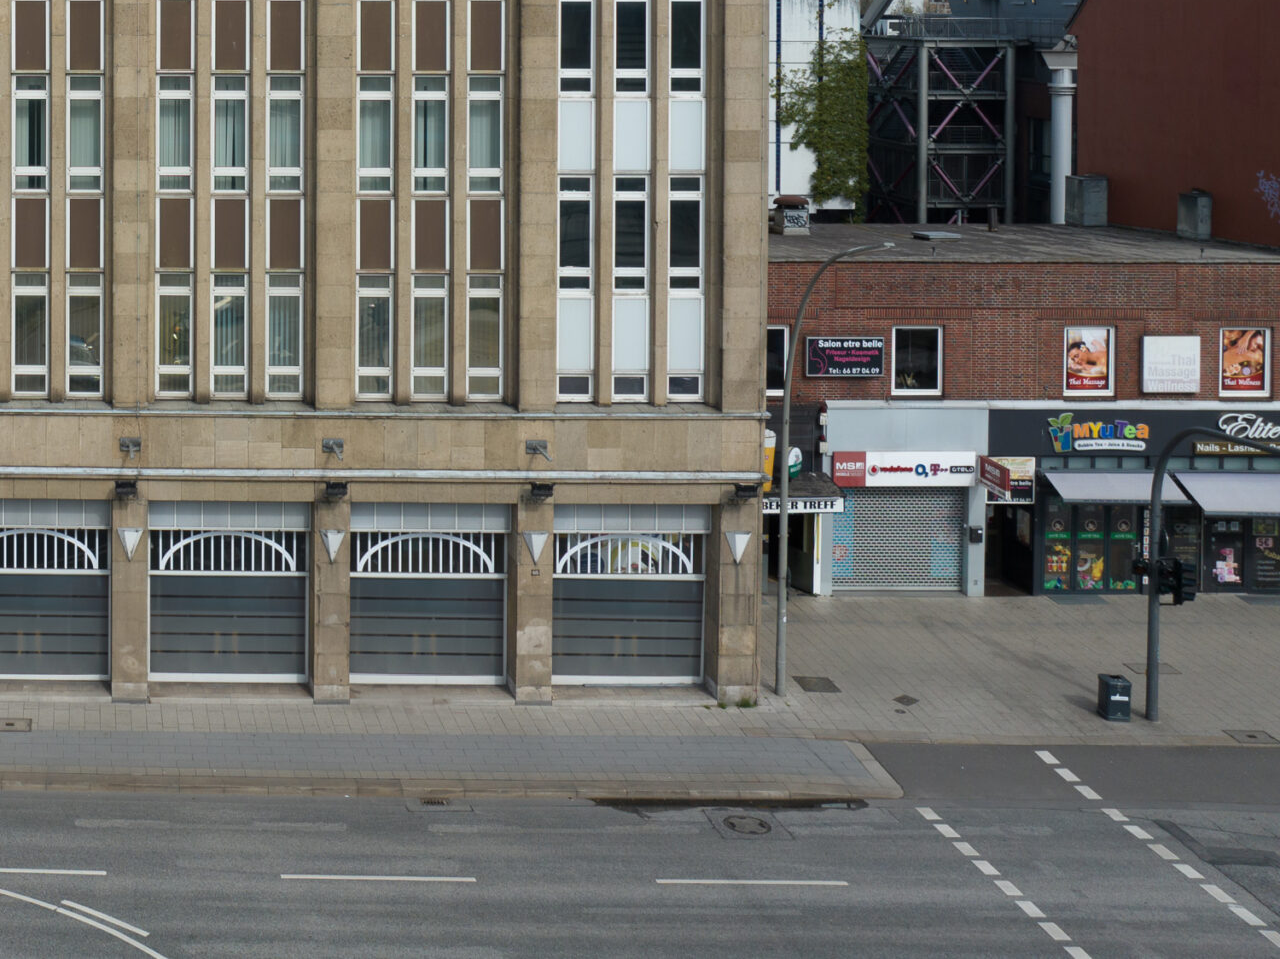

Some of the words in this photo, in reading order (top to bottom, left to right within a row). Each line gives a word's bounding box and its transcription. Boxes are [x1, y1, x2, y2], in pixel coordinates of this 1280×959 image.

[818, 340, 841, 348] Salon
[843, 340, 861, 348] etre
[862, 340, 883, 348] belle
[1170, 353, 1196, 366] Thai
[1147, 366, 1197, 379] Massage
[1147, 380, 1197, 392] Wellness
[1218, 413, 1280, 439] Elite
[1196, 443, 1220, 452] Nails
[879, 465, 914, 473] vodafone
[803, 499, 836, 510] TREFF
